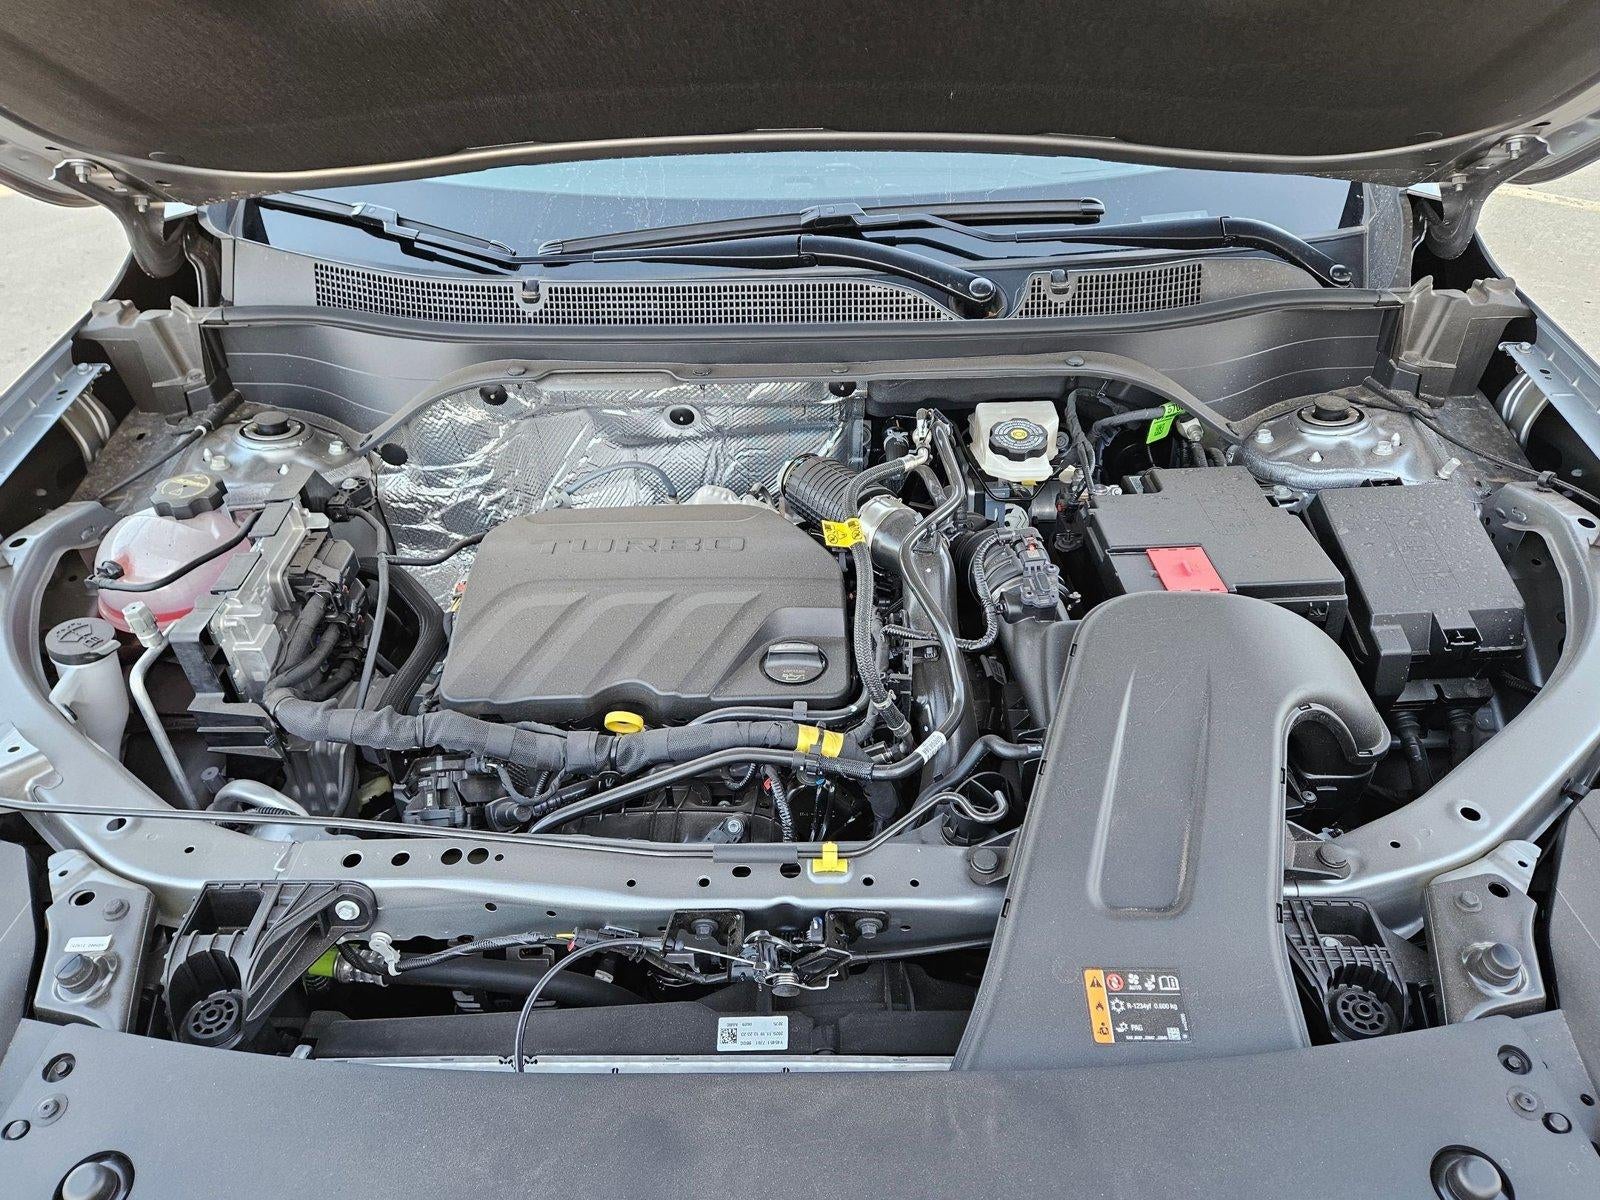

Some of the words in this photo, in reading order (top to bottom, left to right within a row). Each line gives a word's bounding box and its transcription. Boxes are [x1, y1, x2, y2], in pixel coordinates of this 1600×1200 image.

[529, 535, 750, 555] TURBO
[1126, 1002, 1152, 1011] R-1234yf
[1169, 1002, 1179, 1011] kg
[1130, 1024, 1144, 1032] PAG
